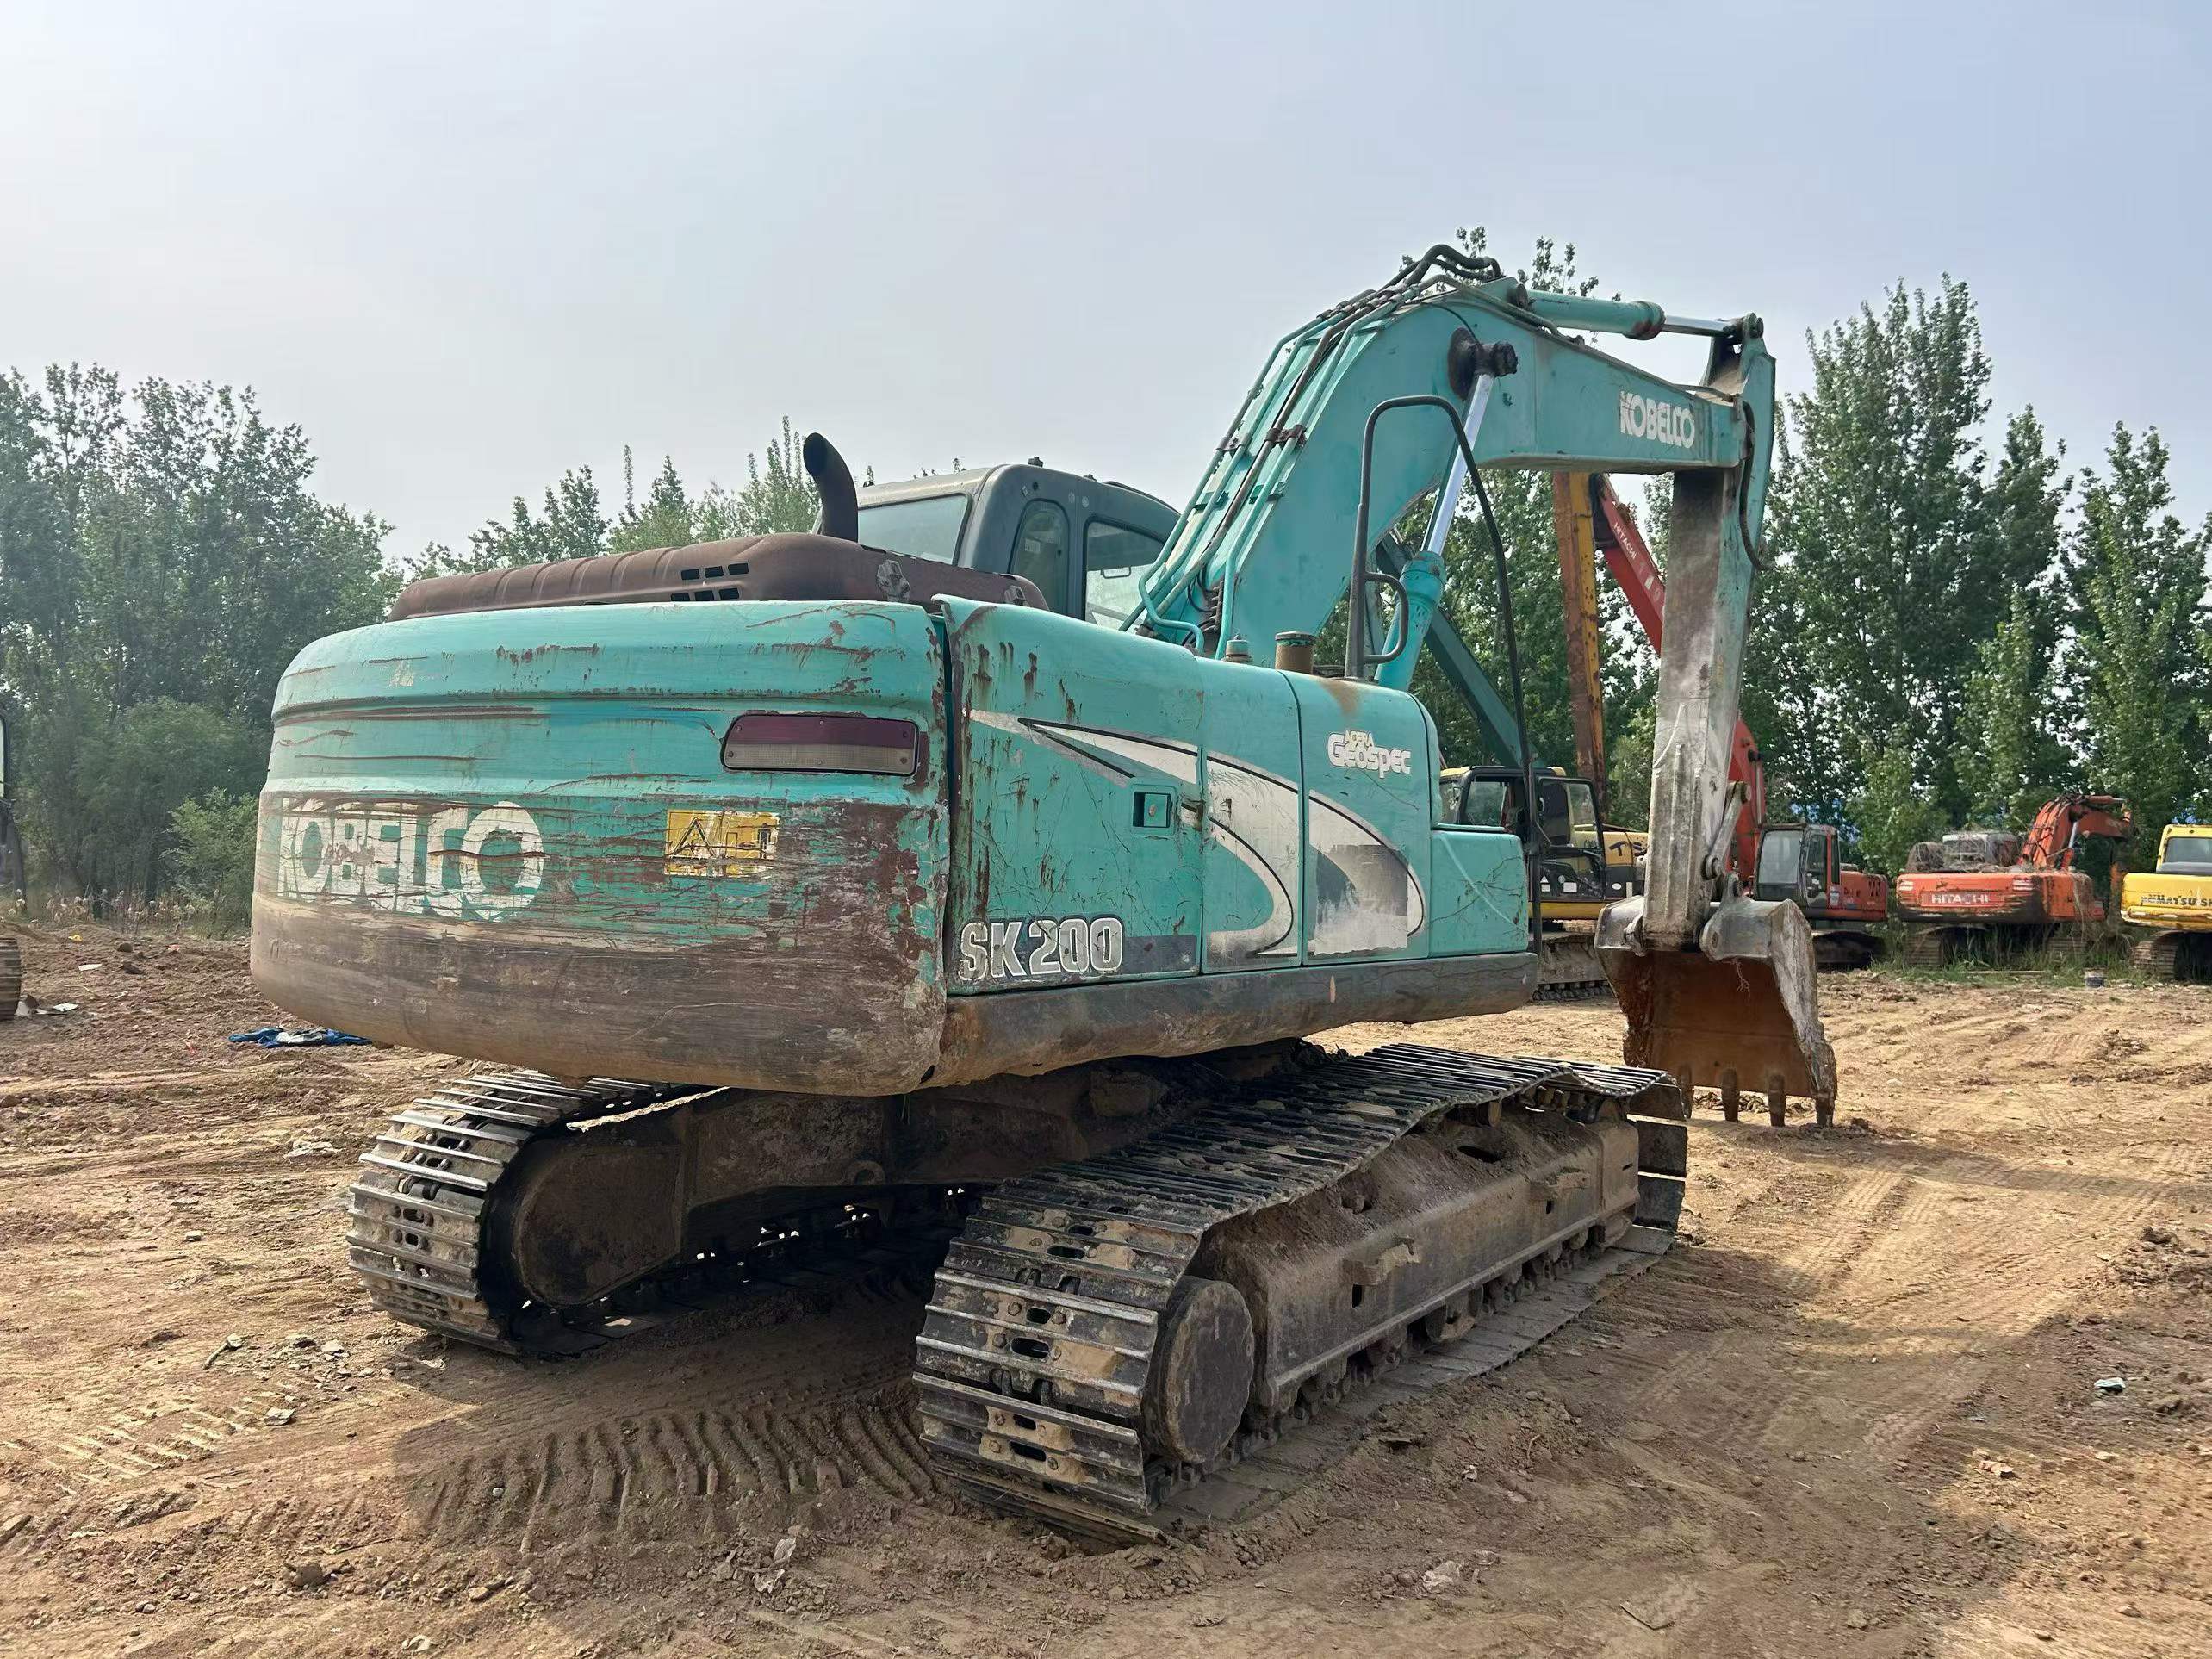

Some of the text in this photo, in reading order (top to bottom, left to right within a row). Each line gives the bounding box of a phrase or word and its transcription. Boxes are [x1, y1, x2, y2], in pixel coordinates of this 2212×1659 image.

[1620, 390, 1695, 448] KOBELCO
[1613, 522, 1637, 560] HITACHI
[1931, 893, 1989, 904] HITACHI
